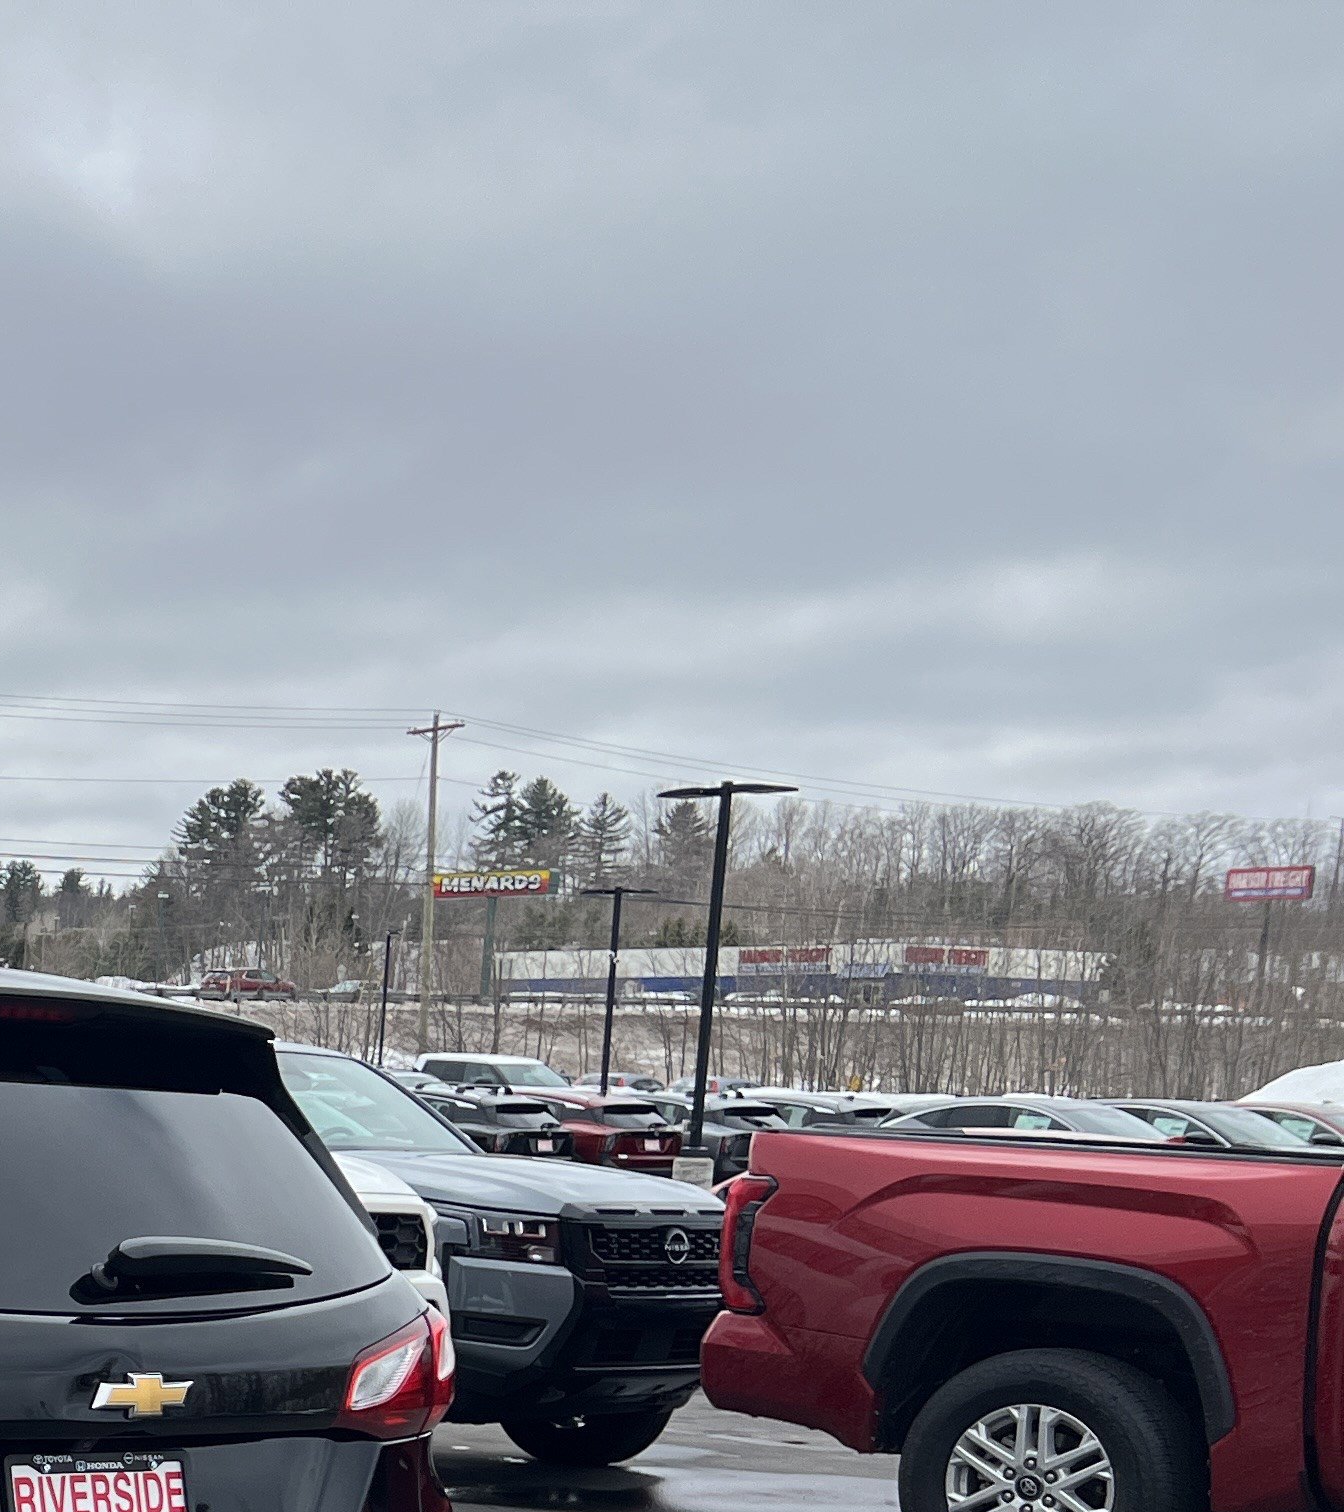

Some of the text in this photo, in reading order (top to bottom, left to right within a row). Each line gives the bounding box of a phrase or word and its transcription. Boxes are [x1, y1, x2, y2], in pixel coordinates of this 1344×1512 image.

[440, 874, 542, 893] MENARDS
[43, 1455, 73, 1464] TOYOTA
[134, 1454, 164, 1462] NISSAN
[86, 1461, 124, 1470] HONDA
